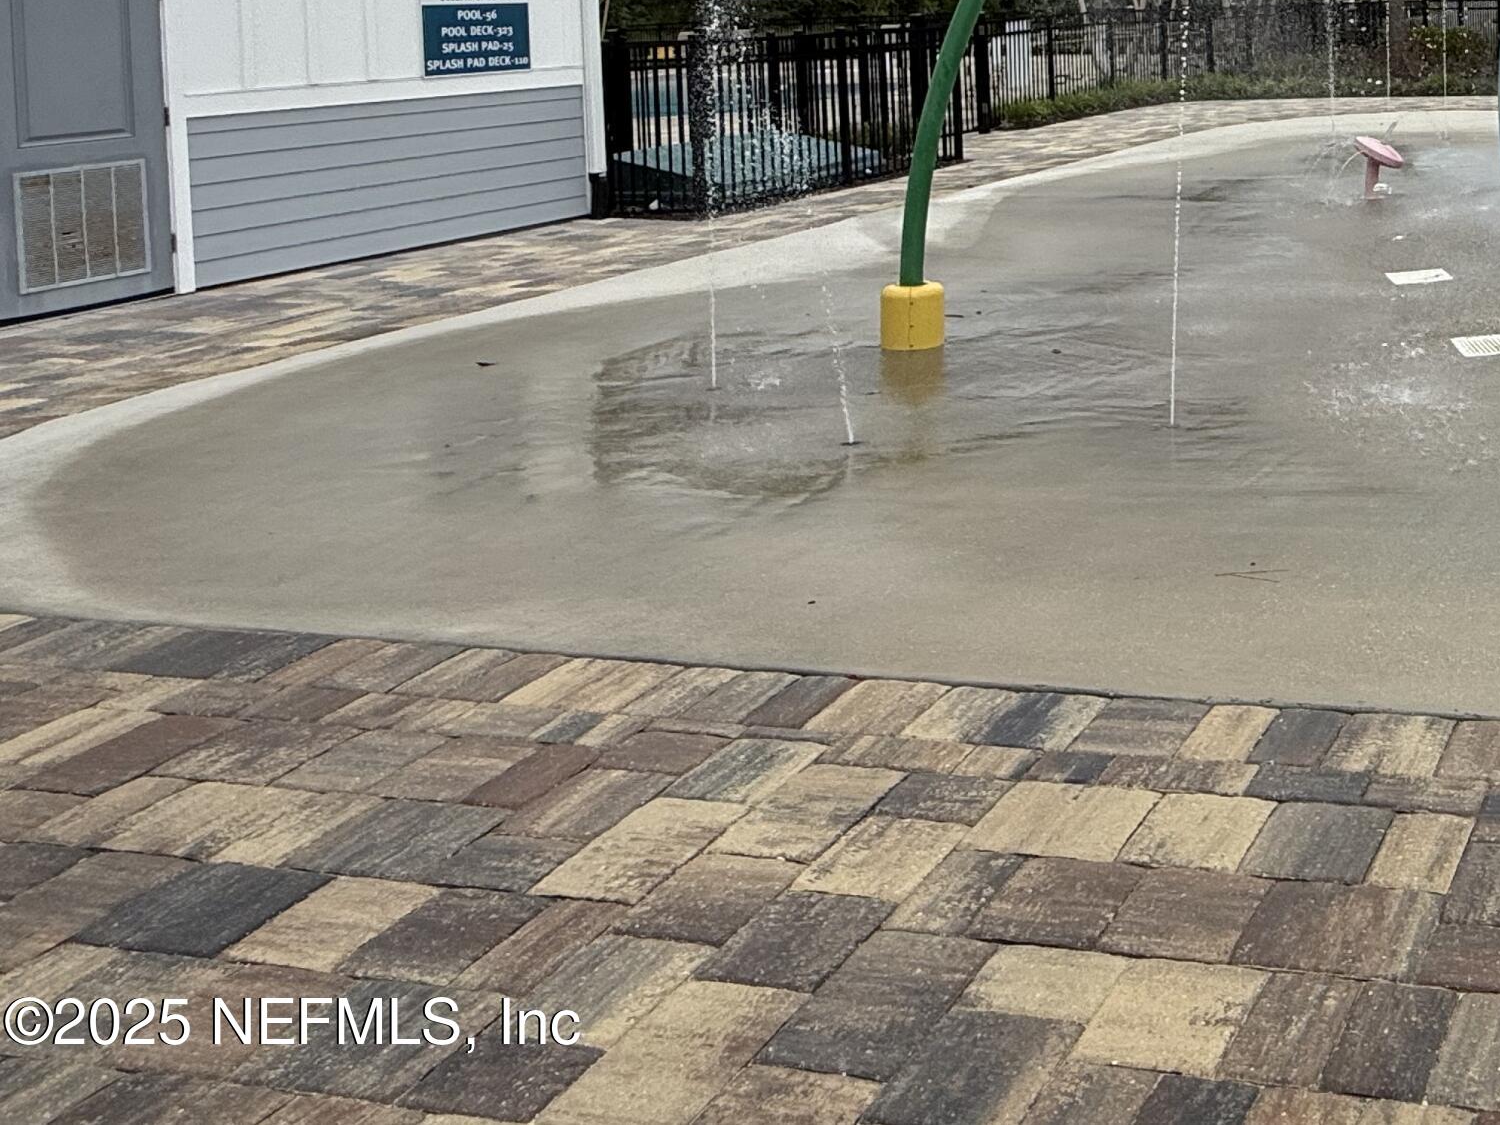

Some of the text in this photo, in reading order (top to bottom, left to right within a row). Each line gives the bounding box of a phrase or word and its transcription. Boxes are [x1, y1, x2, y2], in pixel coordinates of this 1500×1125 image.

[457, 9, 498, 22] POOL-56
[441, 25, 514, 37] POOL DECK-323
[441, 40, 514, 54] SPLASH PAD-25
[426, 55, 529, 71] SPLASH PAD DECK-110
